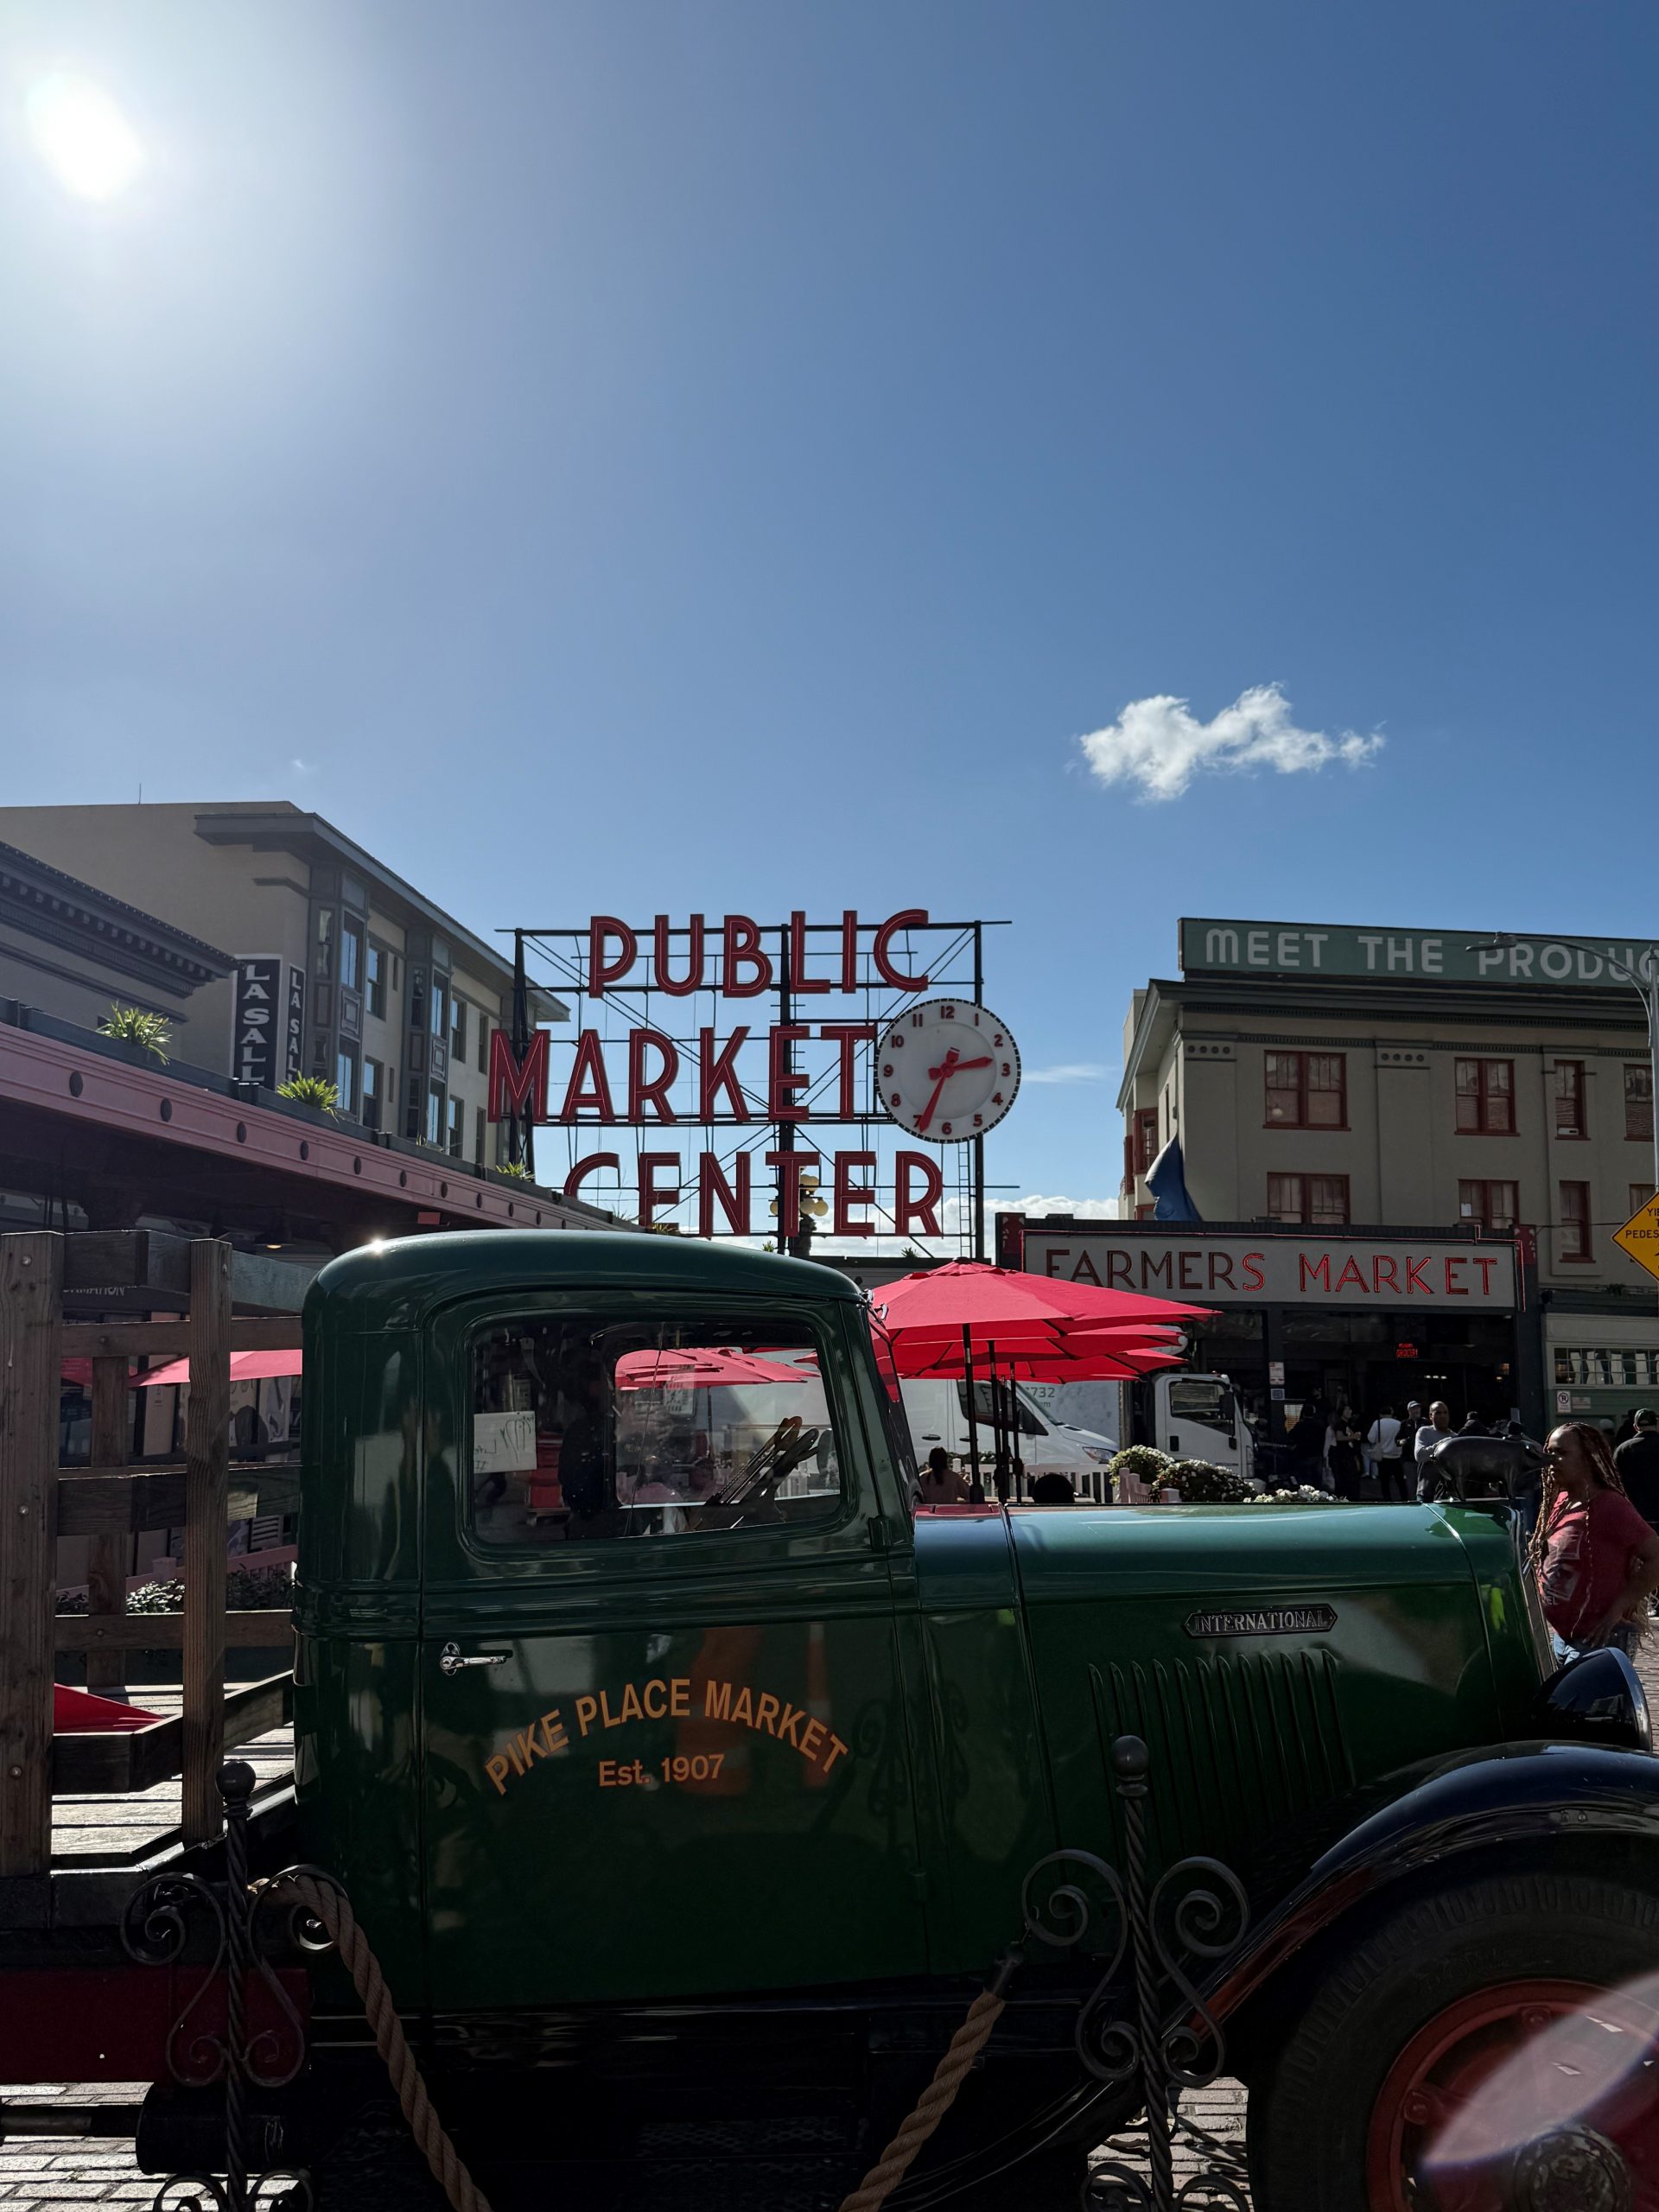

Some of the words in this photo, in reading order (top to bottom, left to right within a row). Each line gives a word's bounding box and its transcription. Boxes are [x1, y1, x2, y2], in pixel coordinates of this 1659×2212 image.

[589, 909, 929, 998] PUBLIC
[1206, 928, 1328, 967] MEET
[1357, 936, 1442, 973] THE
[242, 964, 270, 1000] LA
[290, 971, 302, 1009] LA
[940, 1006, 955, 1020] 12
[975, 1013, 979, 1027] 1
[912, 1014, 923, 1027] 11
[891, 1035, 905, 1048] 10
[994, 1033, 1003, 1047] 2
[488, 1026, 875, 1122] MARKET
[883, 1065, 893, 1077] 9
[1001, 1063, 1011, 1077] 3
[891, 1093, 901, 1107] 8
[992, 1092, 1003, 1106] 4
[973, 1114, 982, 1127] 5
[942, 1122, 952, 1135] 6
[1625, 1230, 1659, 1238] PEDES
[1046, 1249, 1265, 1291] FARMERS
[1300, 1254, 1497, 1294] MARKET
[1025, 1387, 1055, 1397] 732
[1194, 1610, 1328, 1632] INTERNATIONAL
[485, 1709, 569, 1796] PIKE
[575, 1679, 690, 1736] PLACE
[704, 1680, 849, 1773] MARKET
[599, 1759, 651, 1787] Est.
[661, 1754, 725, 1783] 1907
